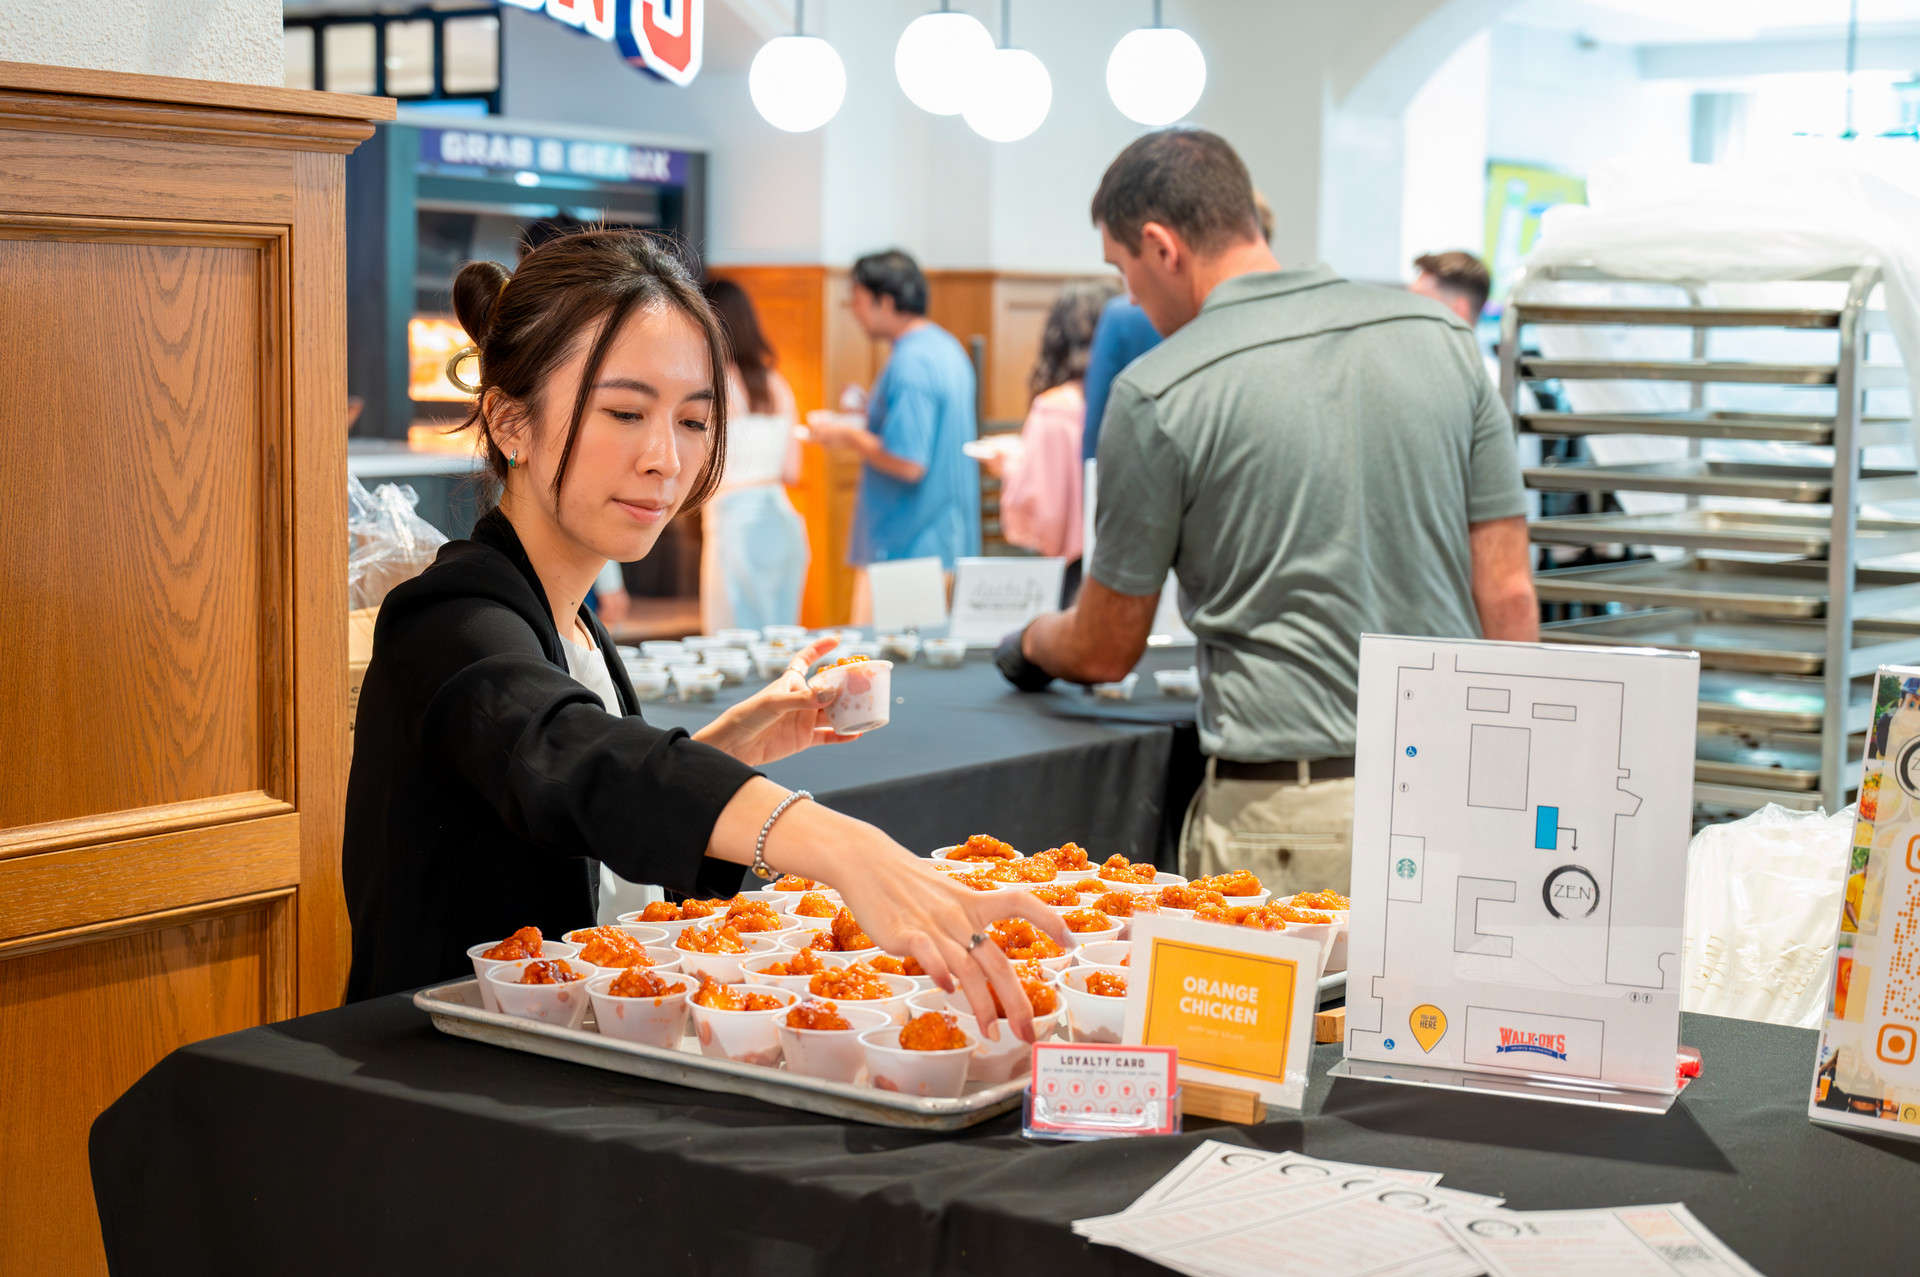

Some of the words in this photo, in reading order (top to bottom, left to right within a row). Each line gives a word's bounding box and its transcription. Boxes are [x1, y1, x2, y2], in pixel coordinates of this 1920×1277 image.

[440, 131, 534, 168] GRAB
[1554, 883, 1591, 900] ZEN
[1183, 976, 1259, 1004] ORANGE
[1179, 997, 1258, 1026] CHICKEN
[1420, 1020, 1438, 1030] HERE
[1060, 1056, 1110, 1067] LOYALTY
[1115, 1058, 1146, 1068] CARD
